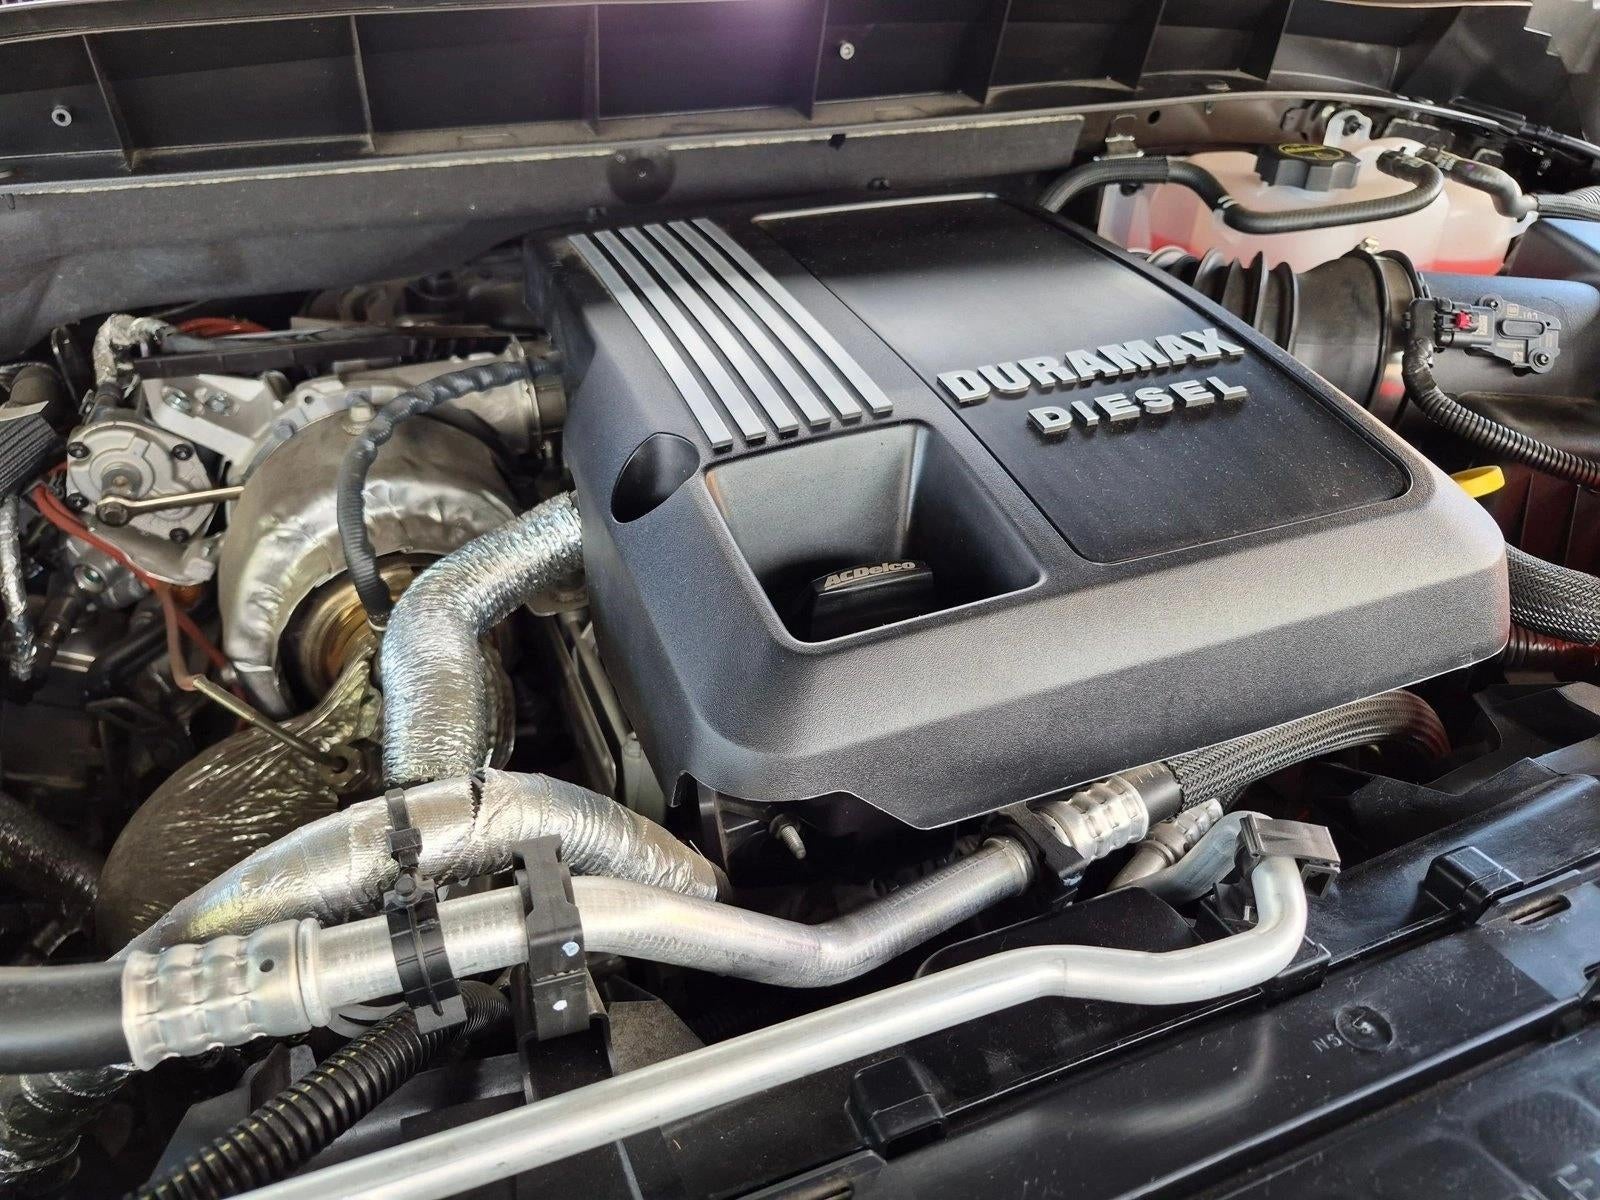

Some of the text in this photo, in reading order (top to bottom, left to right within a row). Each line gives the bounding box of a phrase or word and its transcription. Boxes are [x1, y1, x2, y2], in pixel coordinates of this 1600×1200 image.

[936, 328, 1245, 403] DURAMAX
[1027, 376, 1247, 433] DIESEL
[823, 562, 916, 590] ACDelco
